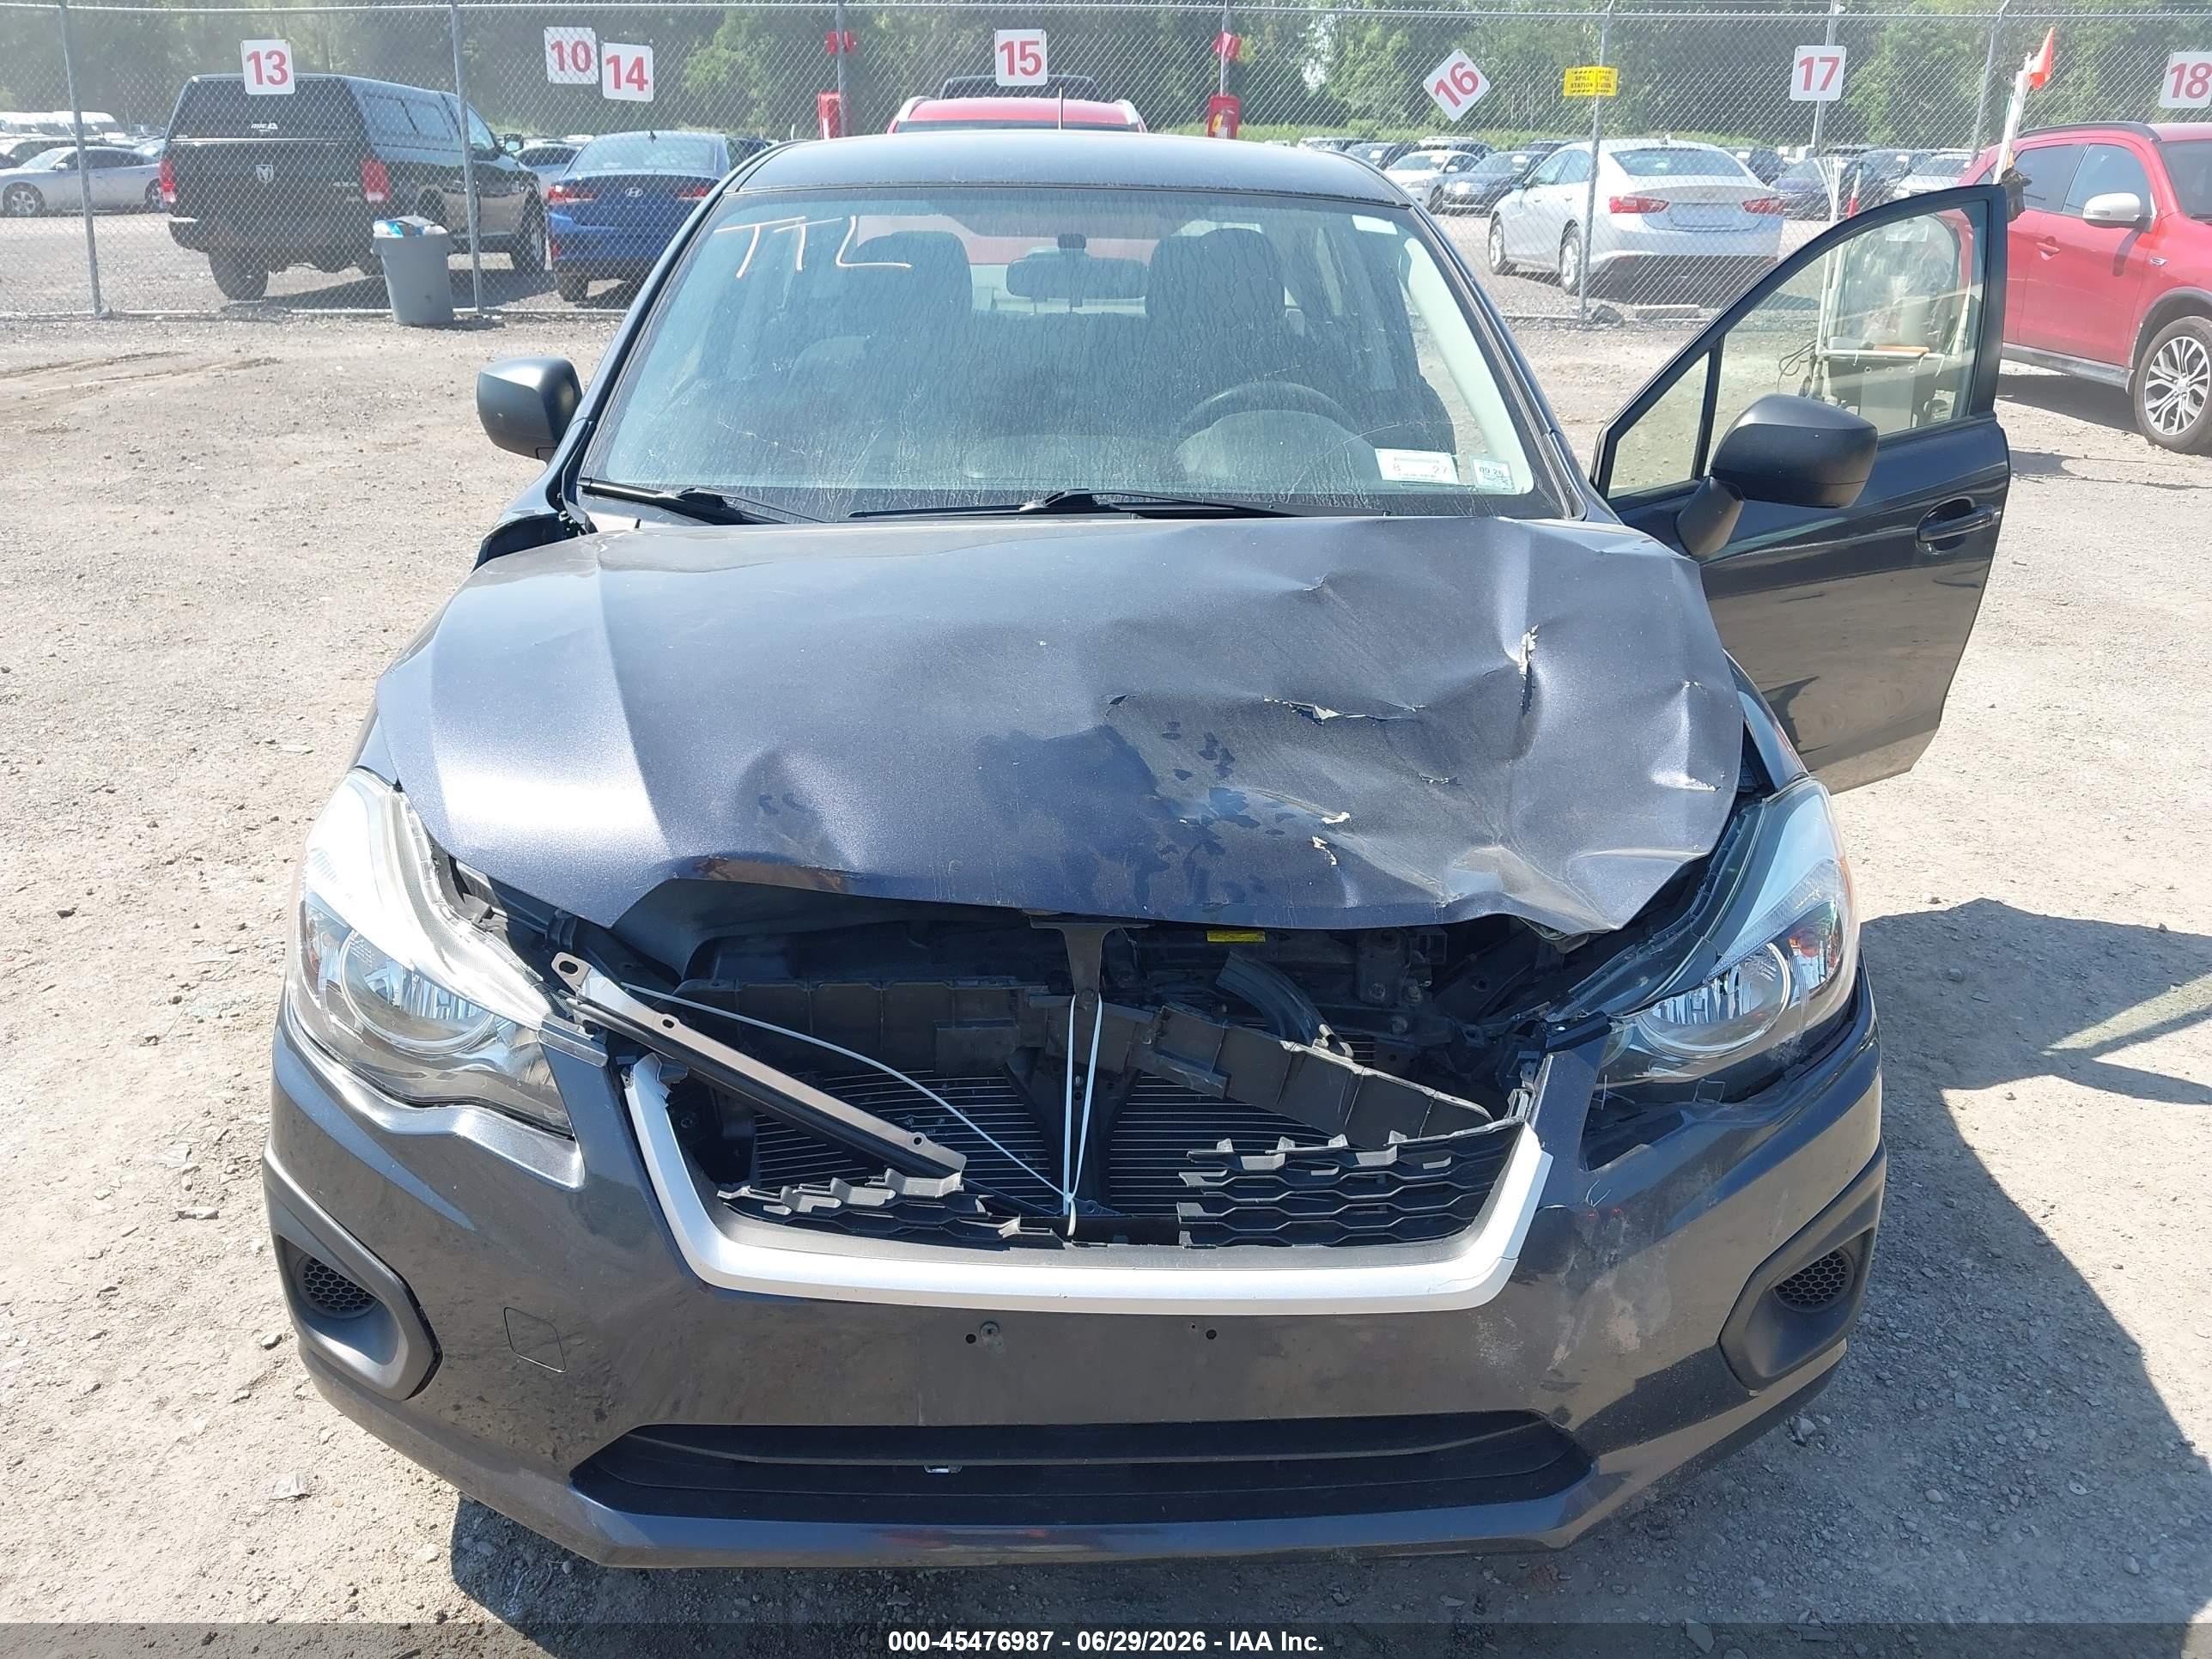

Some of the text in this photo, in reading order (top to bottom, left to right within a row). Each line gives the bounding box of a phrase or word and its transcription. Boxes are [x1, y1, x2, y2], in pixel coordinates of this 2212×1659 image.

[246, 49, 289, 86] 13
[550, 40, 592, 73] 10
[605, 54, 649, 92] 14
[999, 40, 1042, 76] 15
[1798, 56, 1840, 91] 17
[1434, 61, 1480, 108] 16
[2169, 62, 2212, 100] 18
